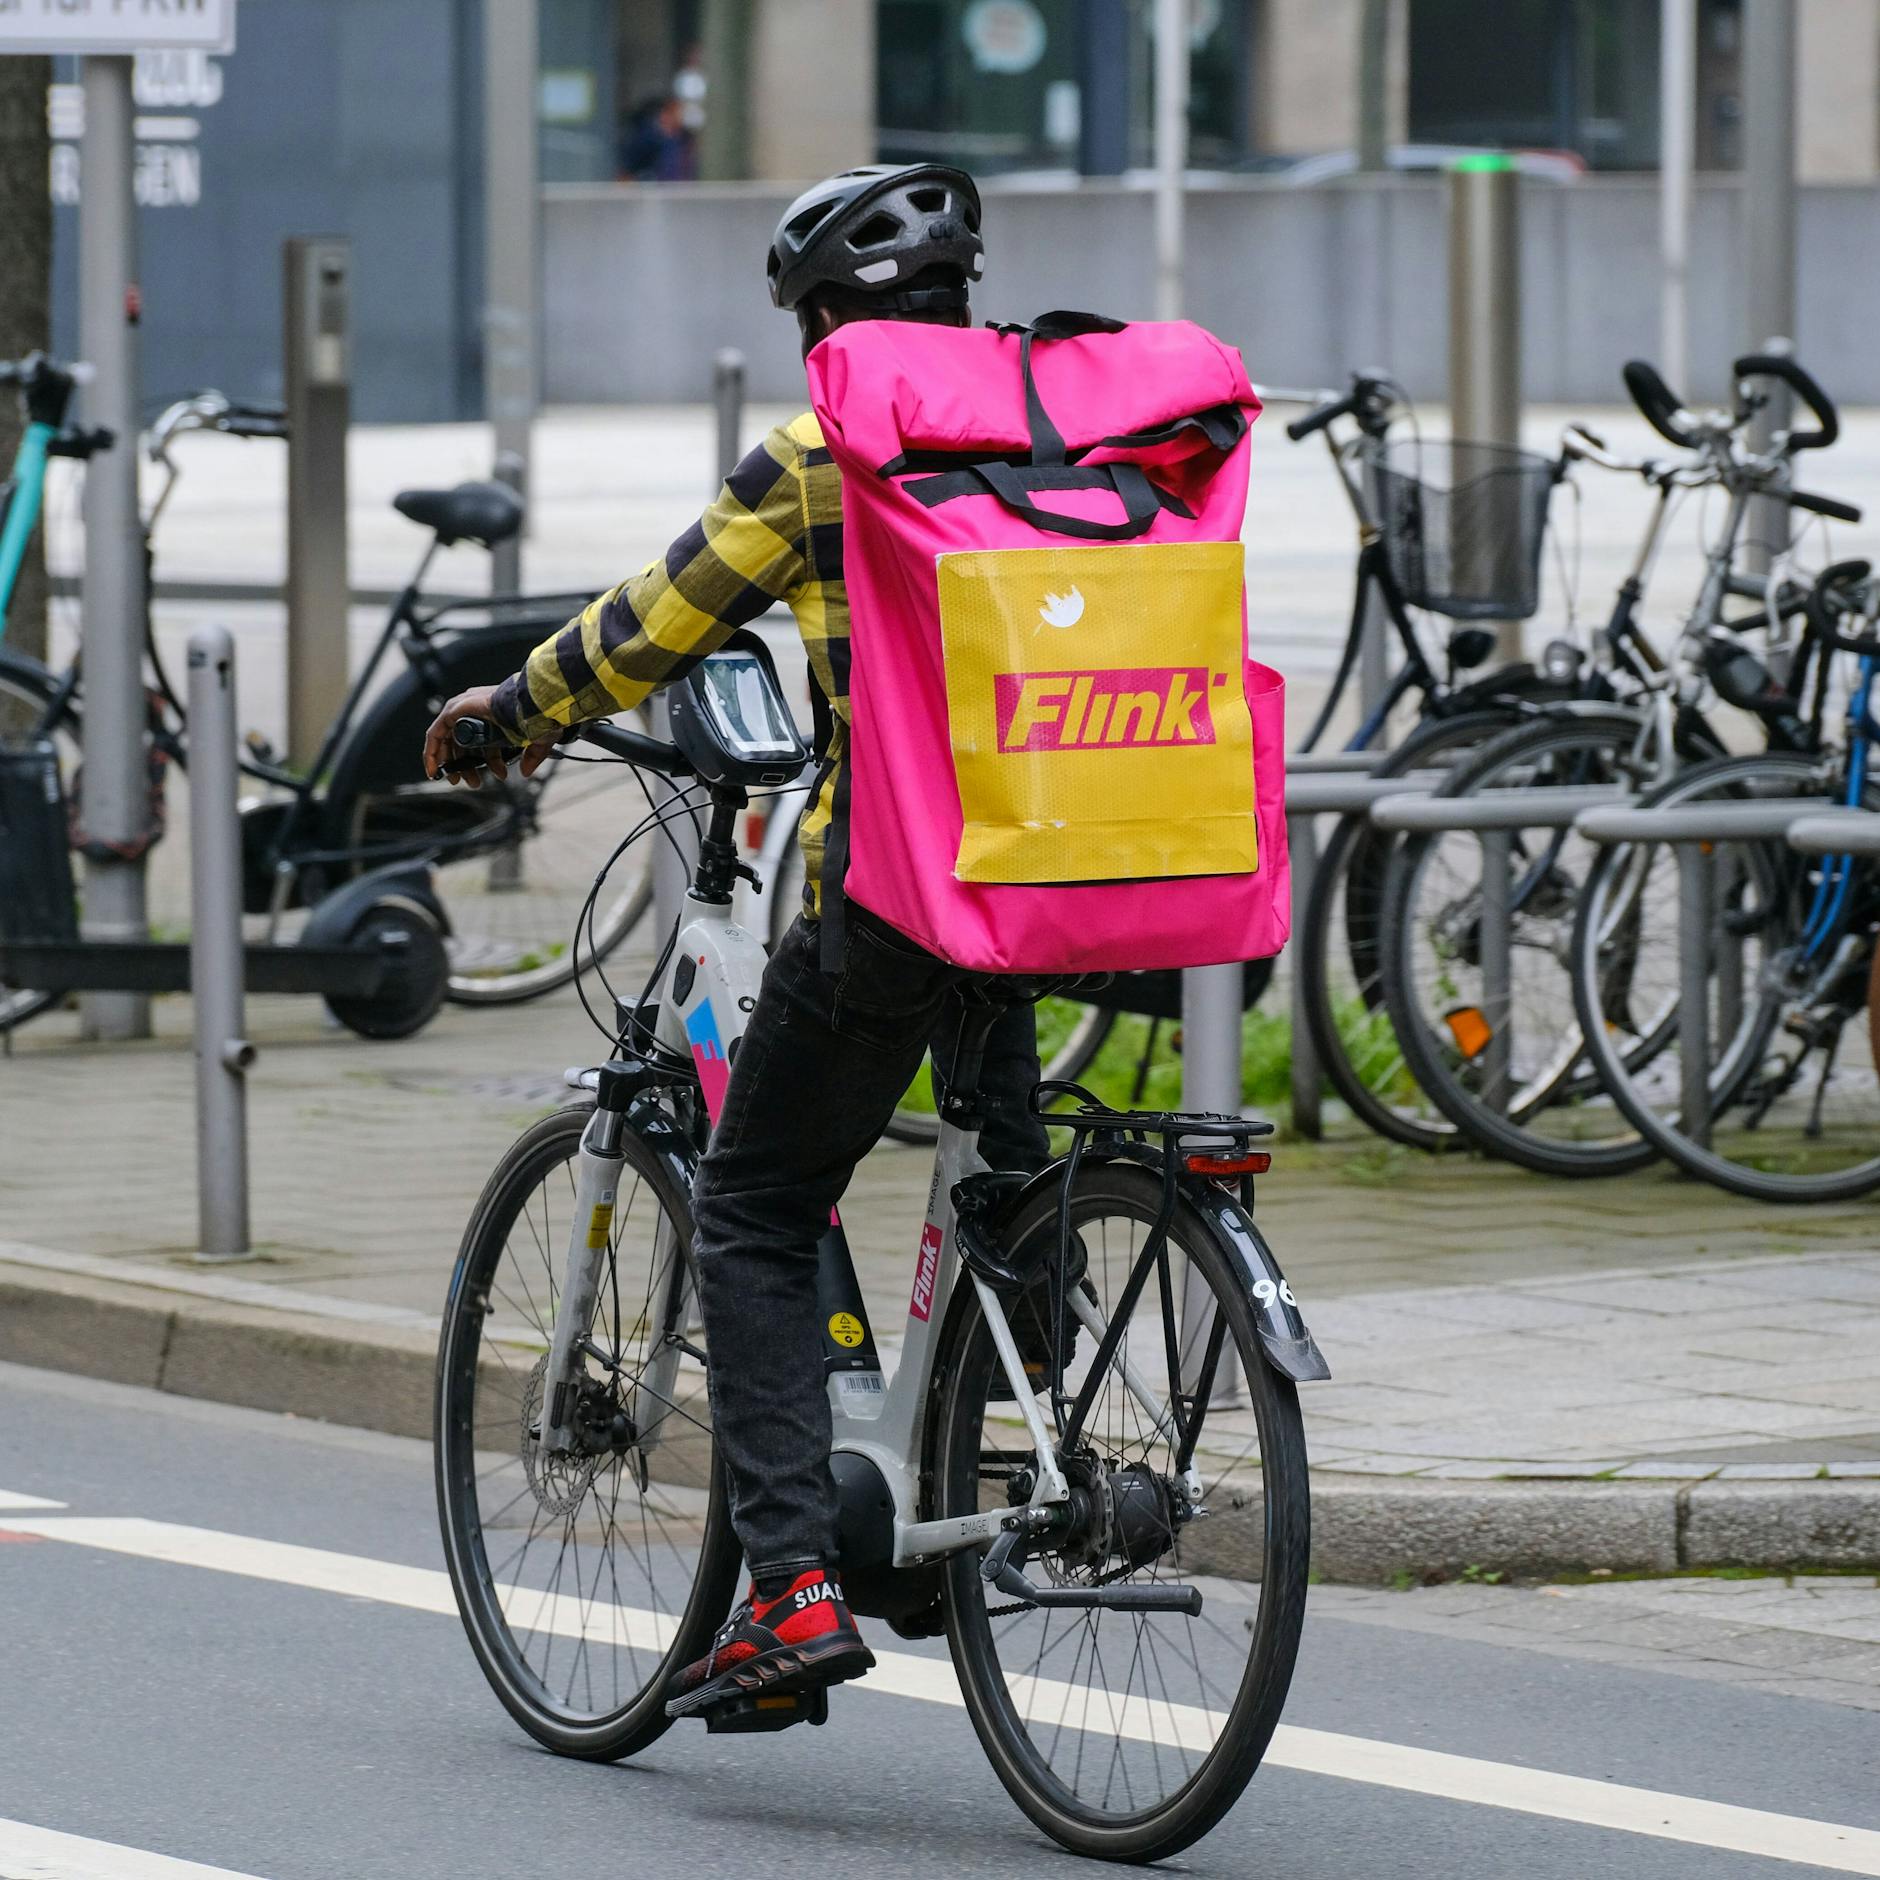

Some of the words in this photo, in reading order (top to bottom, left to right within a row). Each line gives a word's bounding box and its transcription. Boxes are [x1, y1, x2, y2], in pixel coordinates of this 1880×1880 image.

[1004, 673, 1204, 747] Flink
[927, 1169, 941, 1216] IMAGE
[914, 1239, 937, 1314] Flink
[960, 1519, 988, 1536] IMAGE
